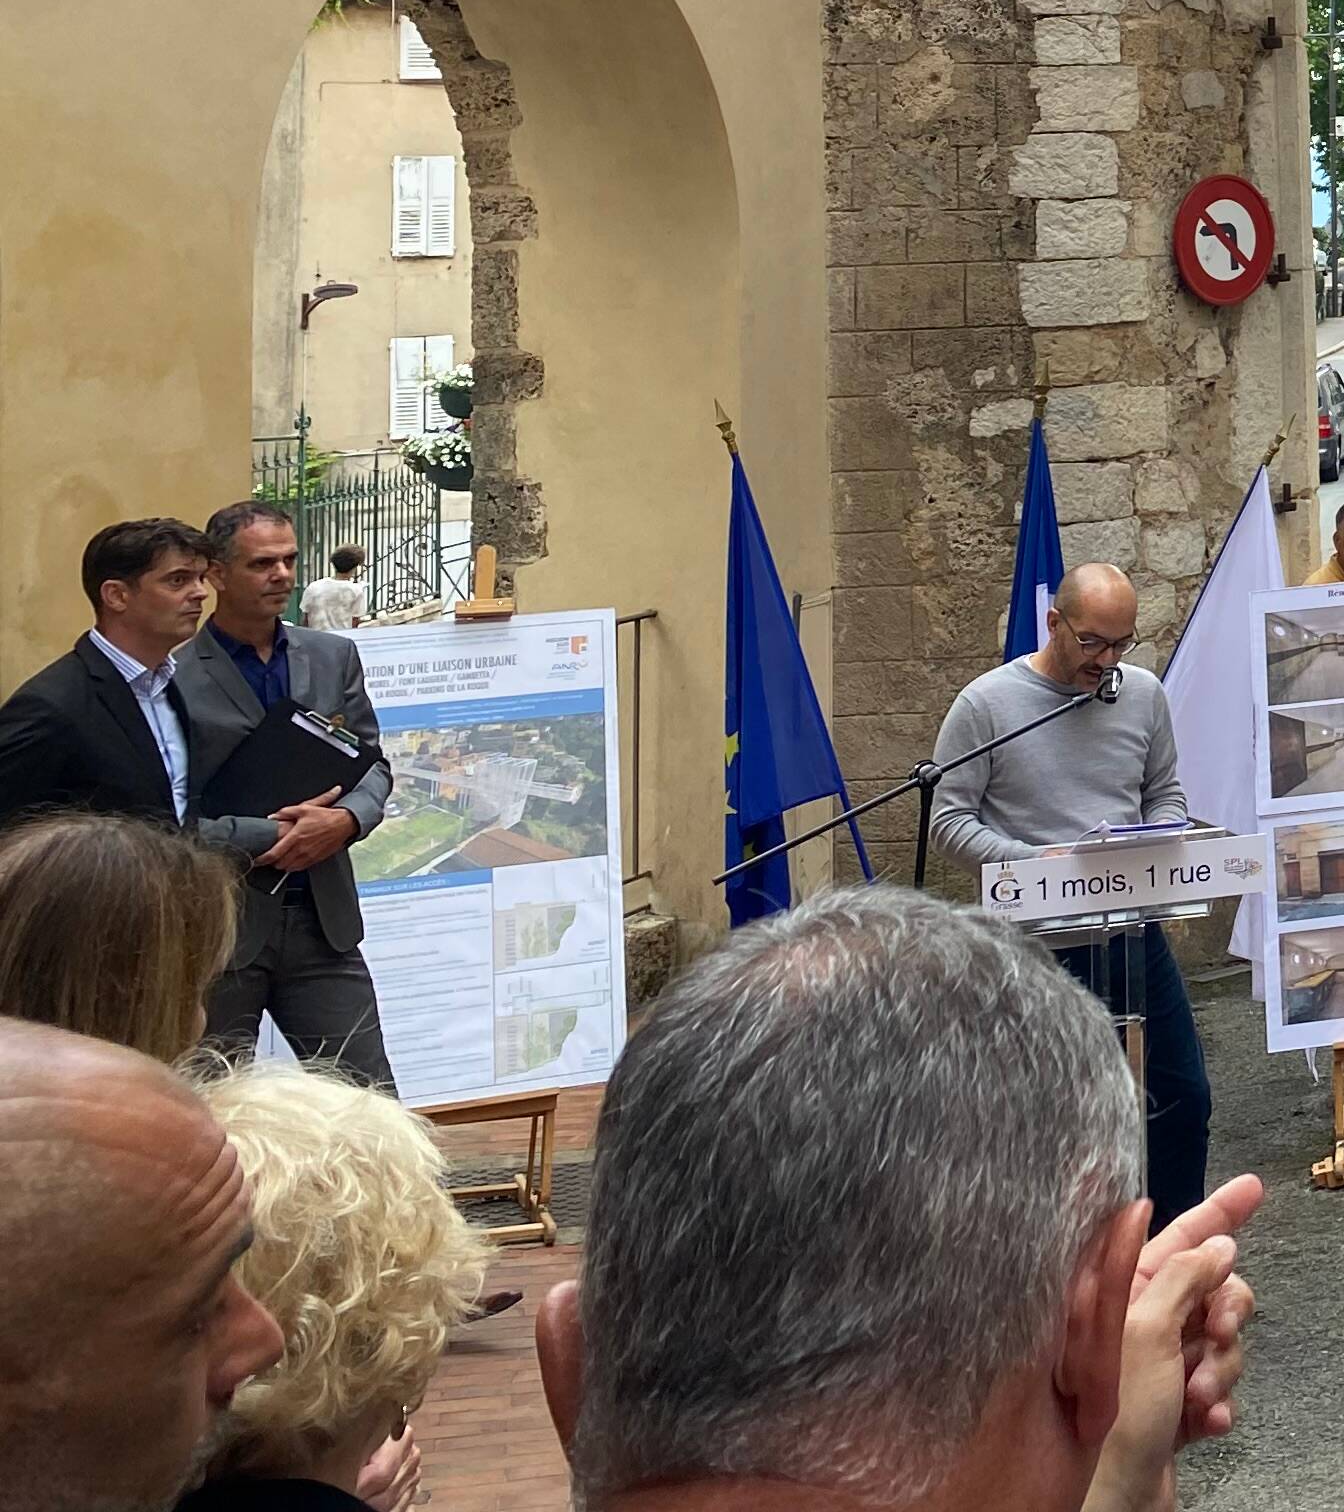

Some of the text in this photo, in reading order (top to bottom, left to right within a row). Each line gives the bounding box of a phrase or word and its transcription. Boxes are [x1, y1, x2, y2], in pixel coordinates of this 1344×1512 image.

[364, 654, 518, 678] ATION D'UNE LIAISON URBAINE
[1036, 863, 1211, 900] 1 mois, 1 rue
